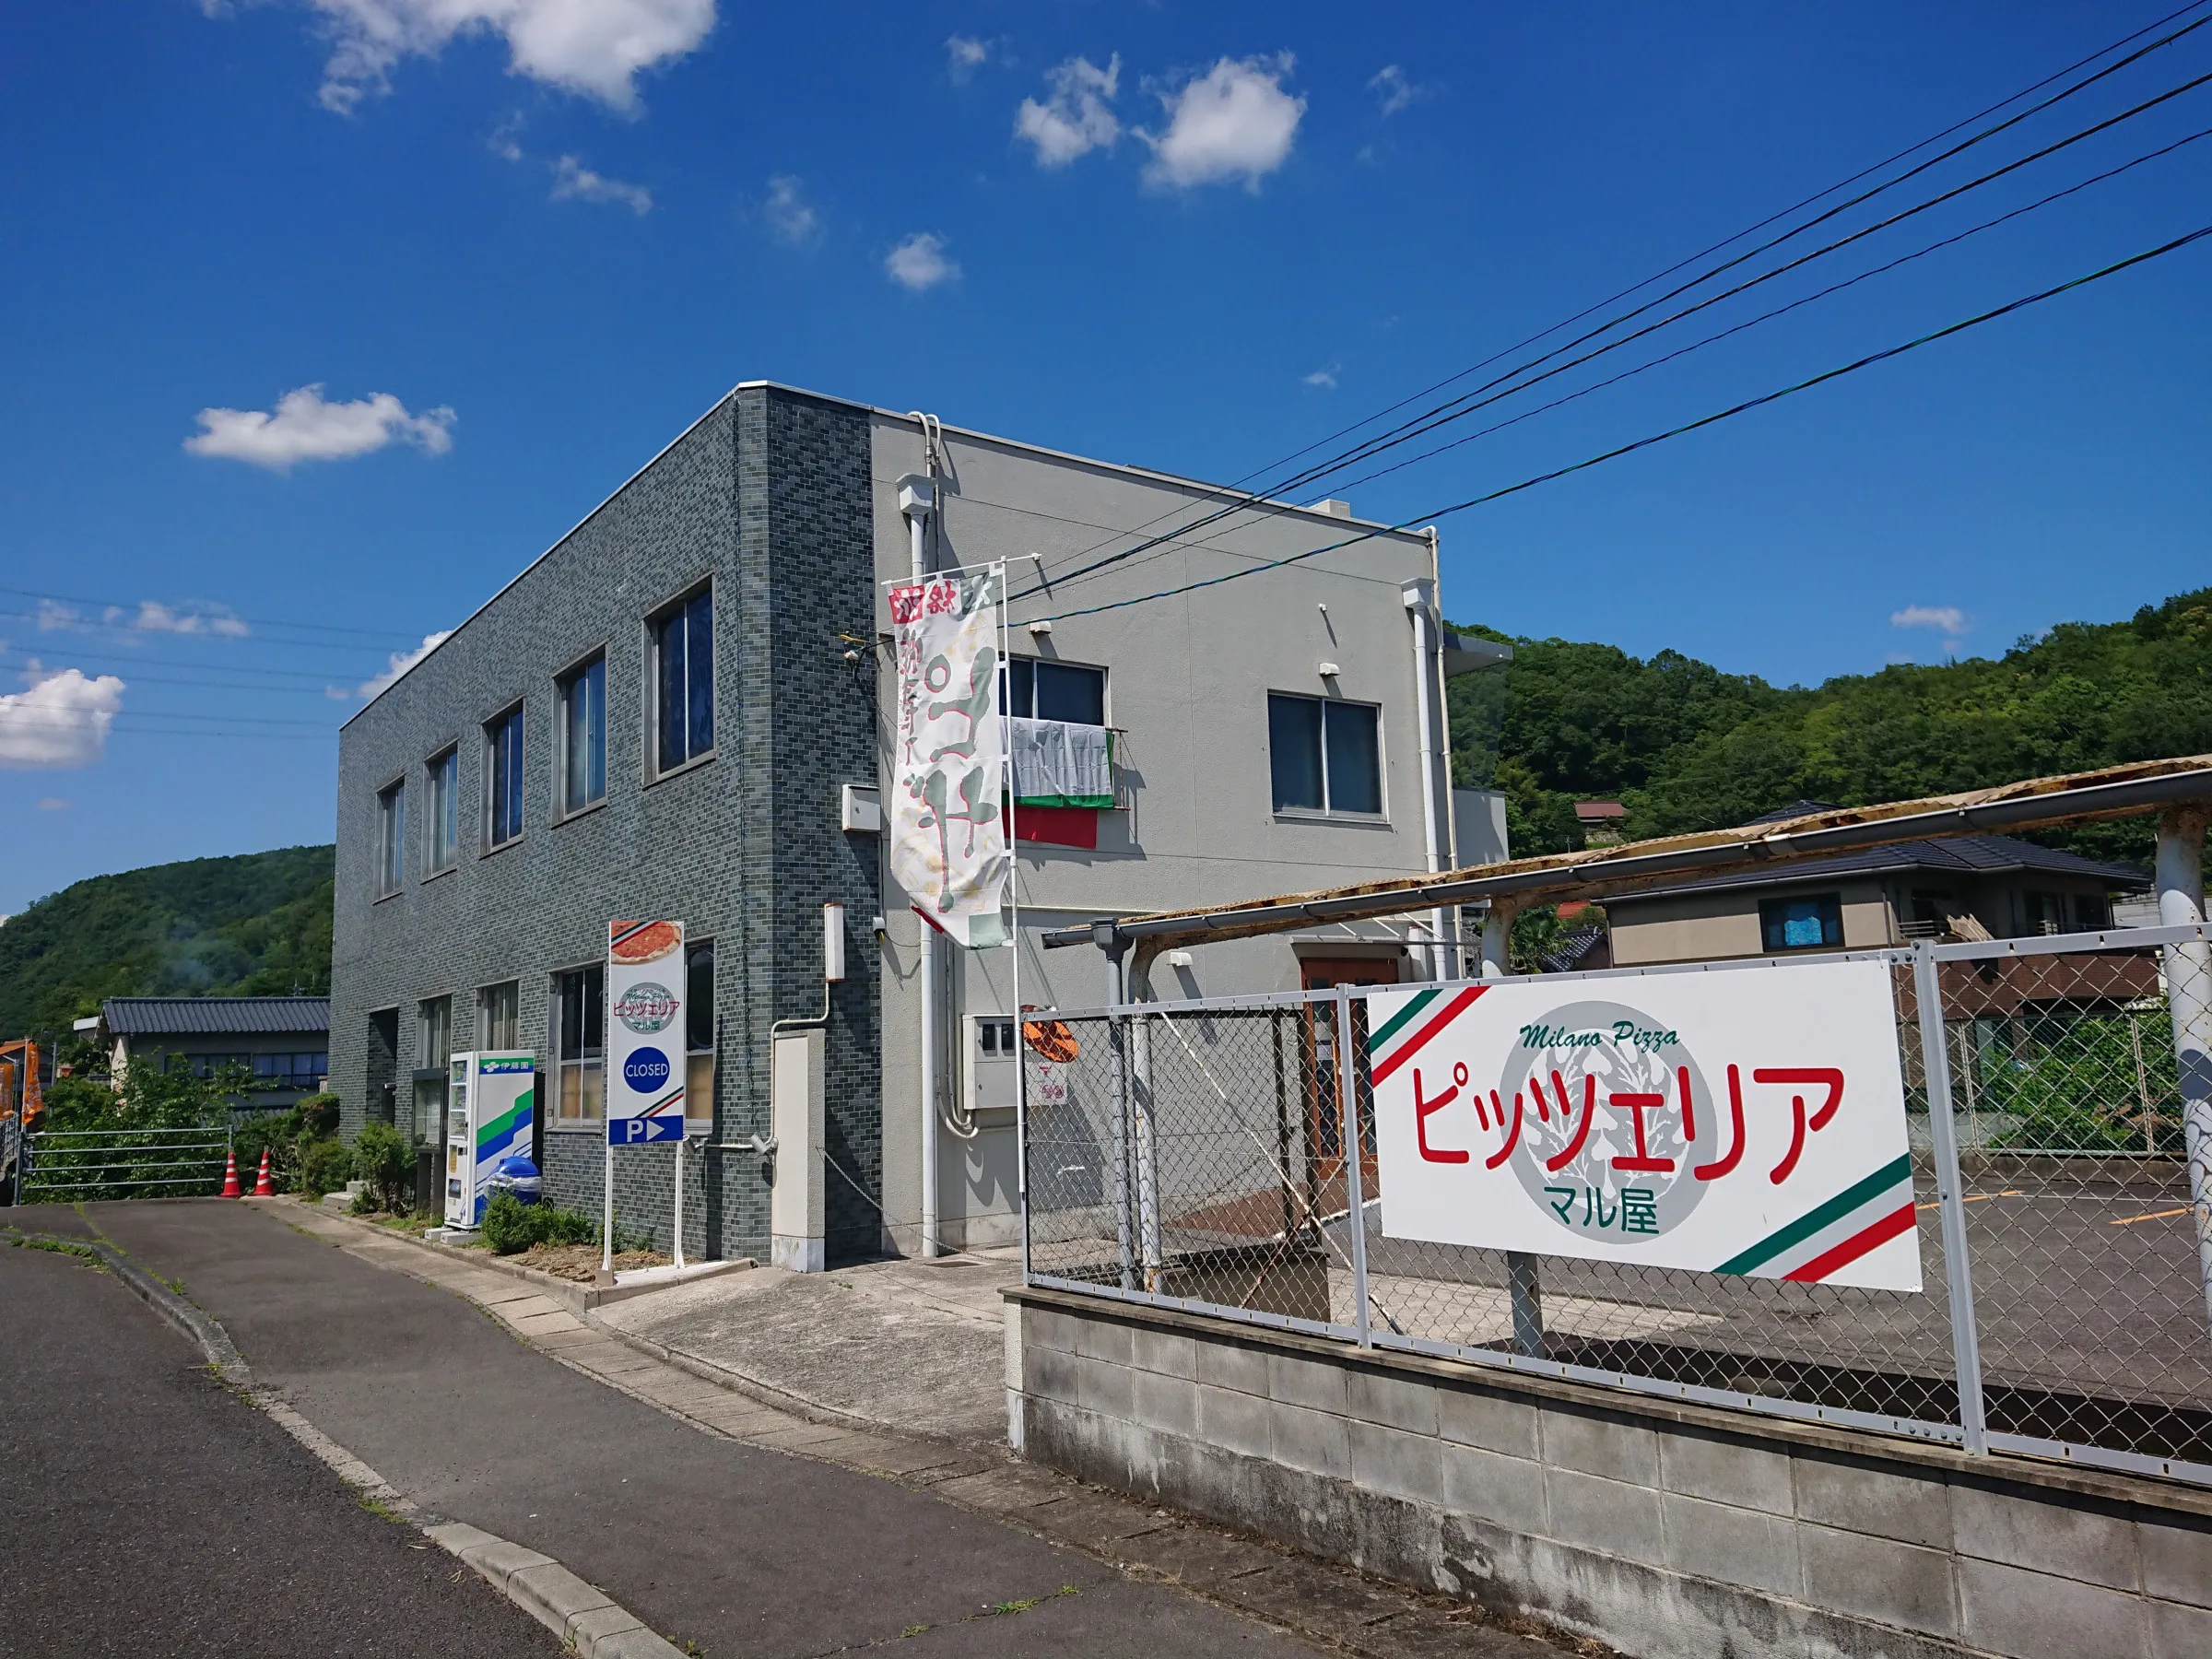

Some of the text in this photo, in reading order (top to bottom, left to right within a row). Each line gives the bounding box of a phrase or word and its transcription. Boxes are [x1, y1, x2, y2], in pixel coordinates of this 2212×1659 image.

[613, 1001, 680, 1017] ピッツェリア
[632, 1021, 661, 1030] マル屋
[1519, 1020, 1680, 1053] Milano Pizza
[500, 1062, 528, 1070] 伊藤園
[626, 1063, 668, 1077] CLOSED
[626, 1120, 644, 1142] P
[1413, 1061, 1844, 1185] ピッツェリア
[1543, 1186, 1660, 1235] マル屋
